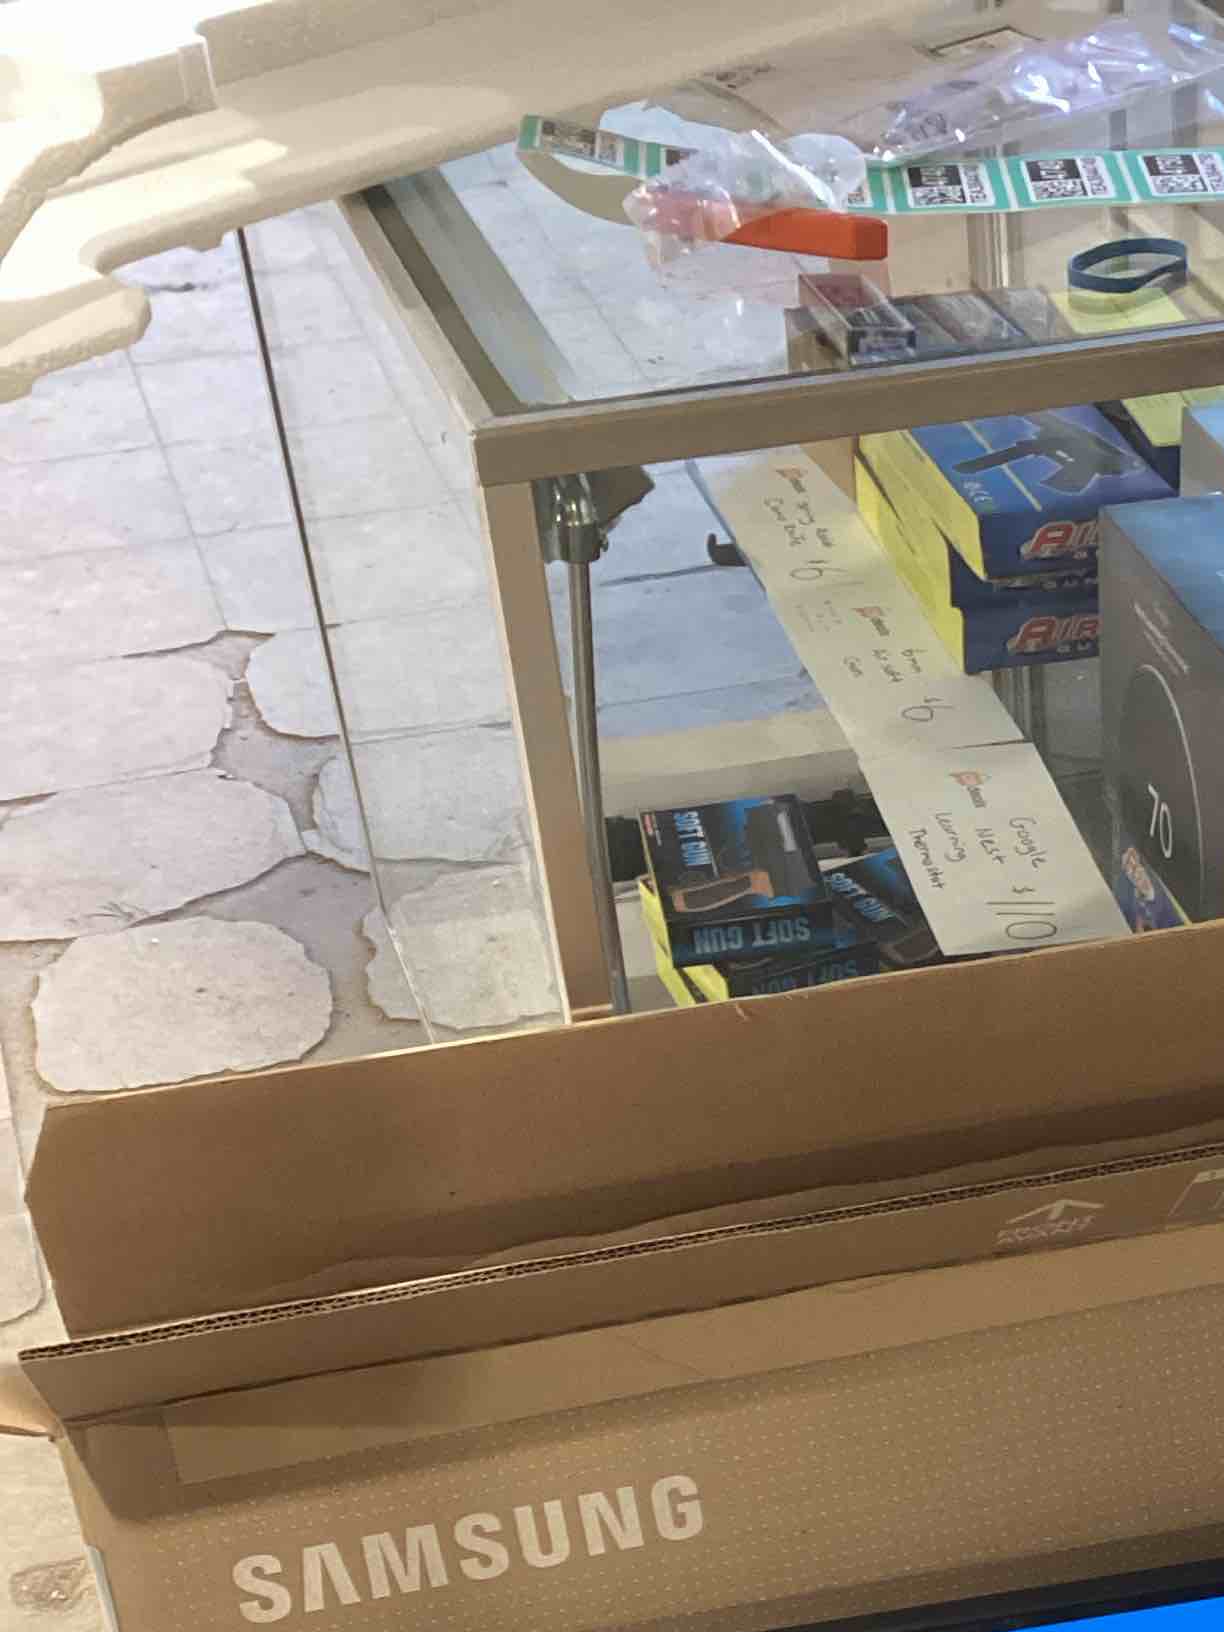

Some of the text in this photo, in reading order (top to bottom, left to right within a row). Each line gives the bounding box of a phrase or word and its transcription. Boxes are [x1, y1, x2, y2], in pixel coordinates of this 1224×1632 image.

[673, 811, 713, 866] SOFT GUN
[909, 827, 948, 891] Thermostat
[975, 827, 1006, 865] Nest
[1008, 816, 1049, 870] Google
[692, 917, 812, 955] SOFT GUN
[232, 1474, 704, 1624] SAMSUNG
